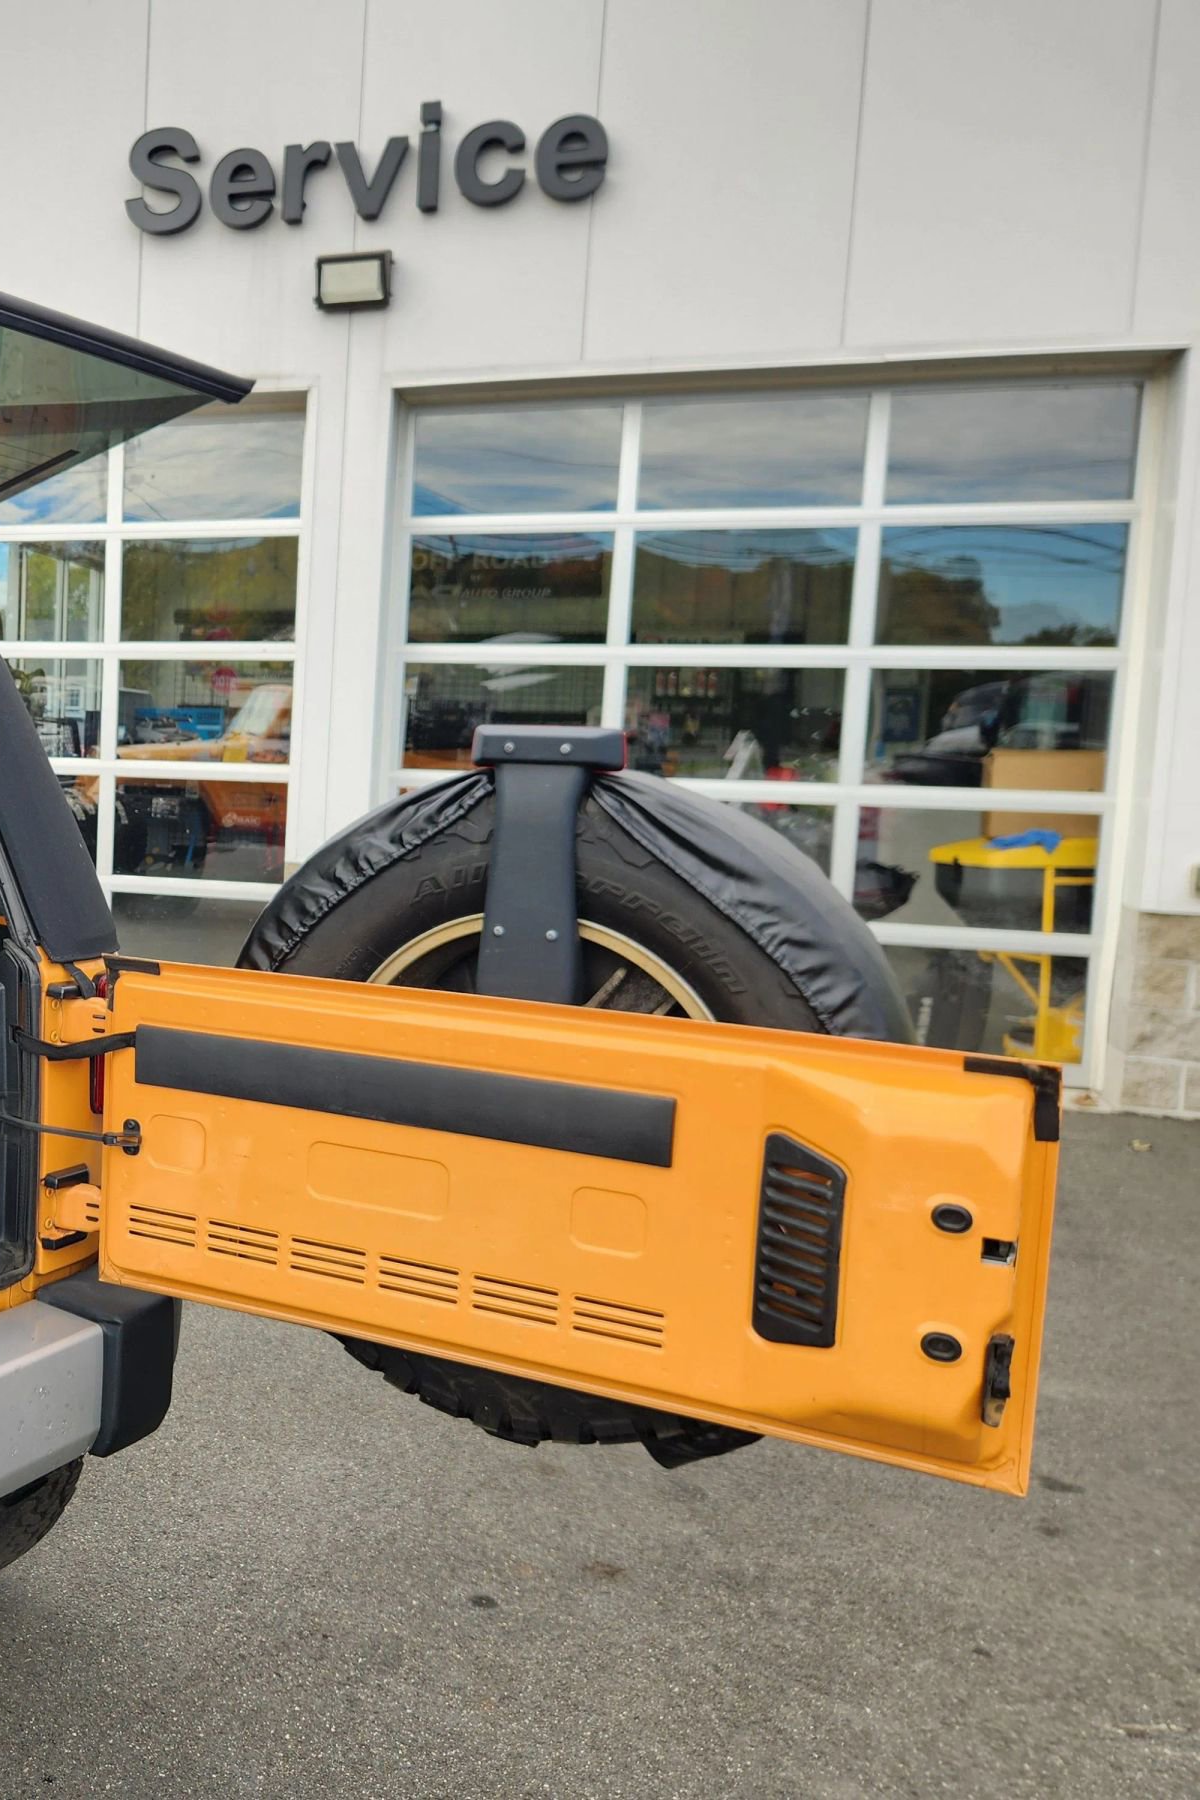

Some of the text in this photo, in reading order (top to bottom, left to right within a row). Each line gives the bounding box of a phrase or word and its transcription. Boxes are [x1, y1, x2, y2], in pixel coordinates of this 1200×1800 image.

[125, 100, 609, 236] Service
[461, 587, 499, 599] AUTO
[501, 586, 552, 599] GROUP
[473, 551, 548, 570] ROAD
[577, 870, 748, 993] rrain
